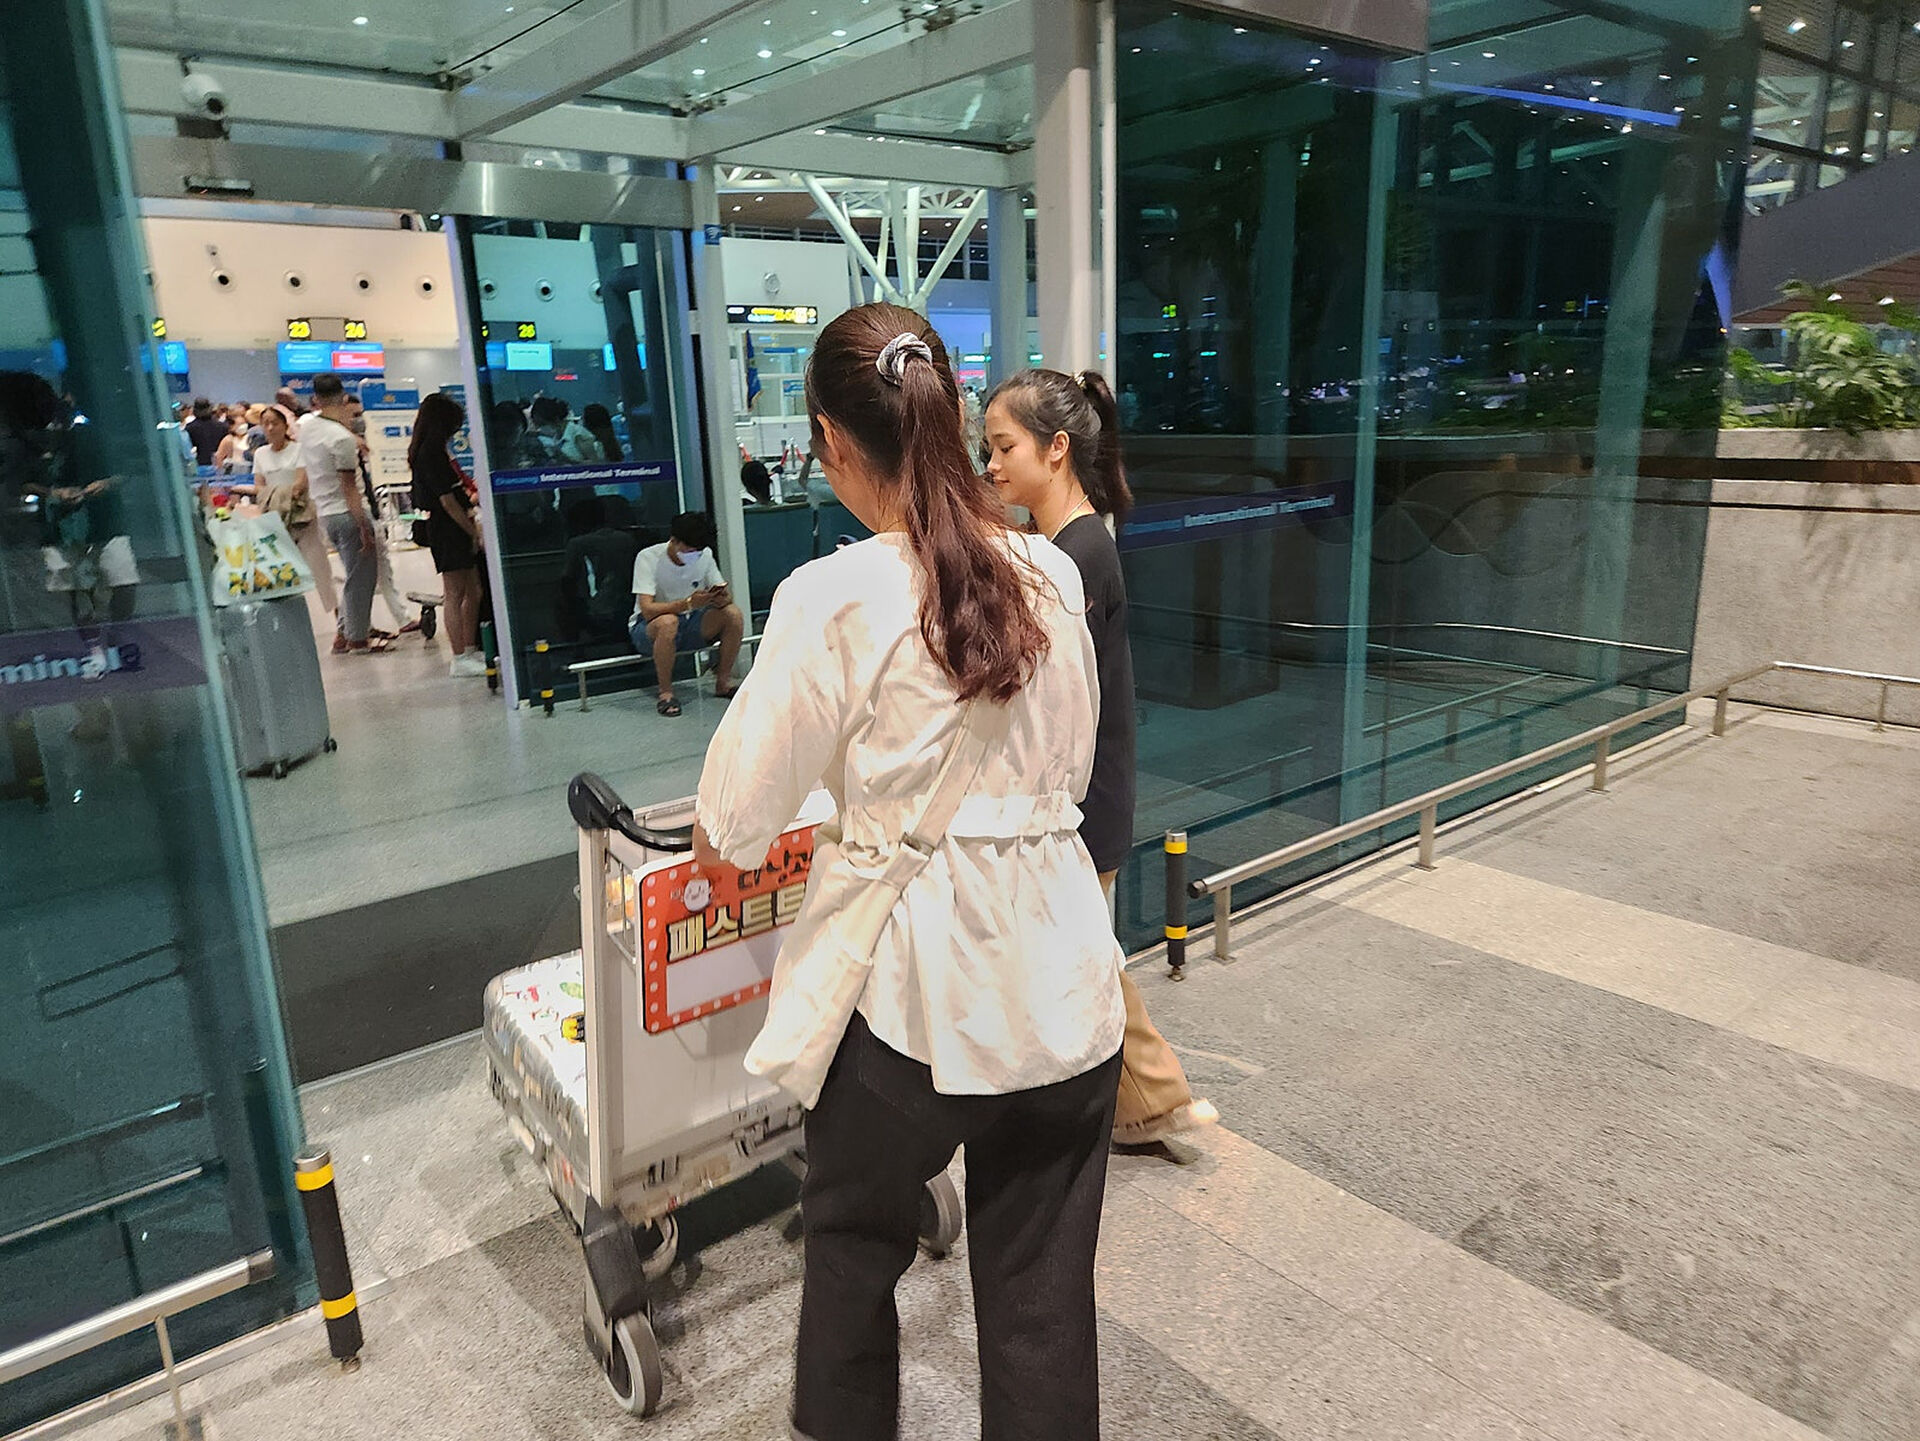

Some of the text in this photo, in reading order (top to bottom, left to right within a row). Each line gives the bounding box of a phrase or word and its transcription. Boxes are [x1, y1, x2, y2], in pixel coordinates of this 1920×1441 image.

[540, 469, 613, 483] International
[614, 466, 661, 478] Terminal
[667, 881, 806, 963] 패스트트
